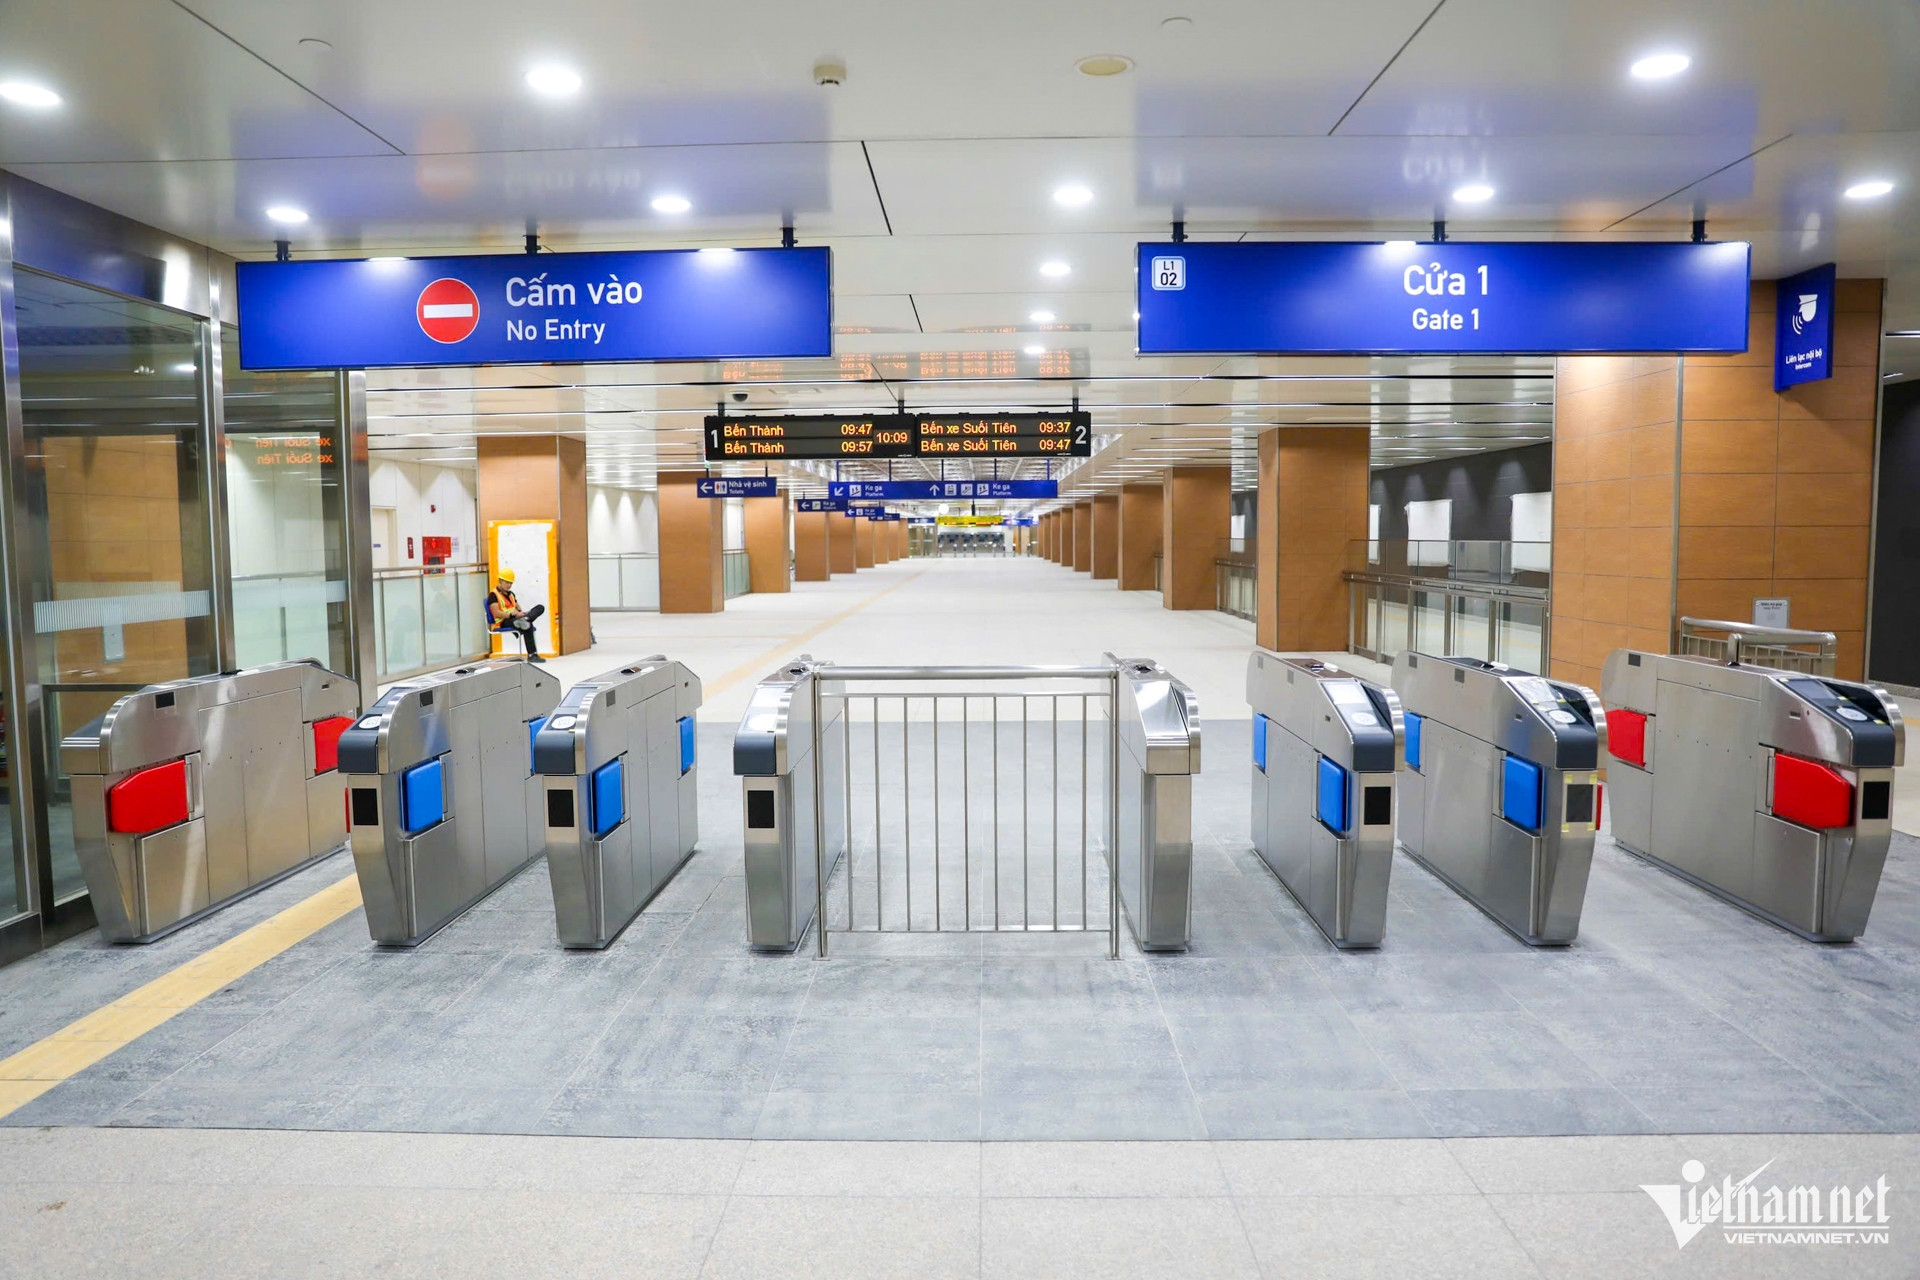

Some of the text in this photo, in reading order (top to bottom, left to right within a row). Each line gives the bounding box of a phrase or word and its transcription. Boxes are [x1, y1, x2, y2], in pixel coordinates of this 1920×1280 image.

[1163, 260, 1174, 270] L1
[1160, 272, 1177, 286] 02
[1403, 262, 1488, 295] Cửa 1
[506, 272, 643, 307] Cấm vào
[1412, 308, 1479, 330] Gate 1
[507, 318, 606, 344] No Entry
[724, 423, 784, 437] Bến Thành
[841, 424, 873, 436] 09:47
[920, 420, 1017, 434] Bến xe Suối Tiên
[1039, 421, 1071, 433] 09:37
[711, 429, 719, 448] 1
[876, 432, 908, 443] 10:09
[1075, 425, 1087, 445] 2
[724, 441, 784, 454] Bến Thành
[841, 441, 873, 453] 09:57
[921, 438, 1017, 452] Bến xe Suối Tiên
[1039, 439, 1071, 450] 09:47
